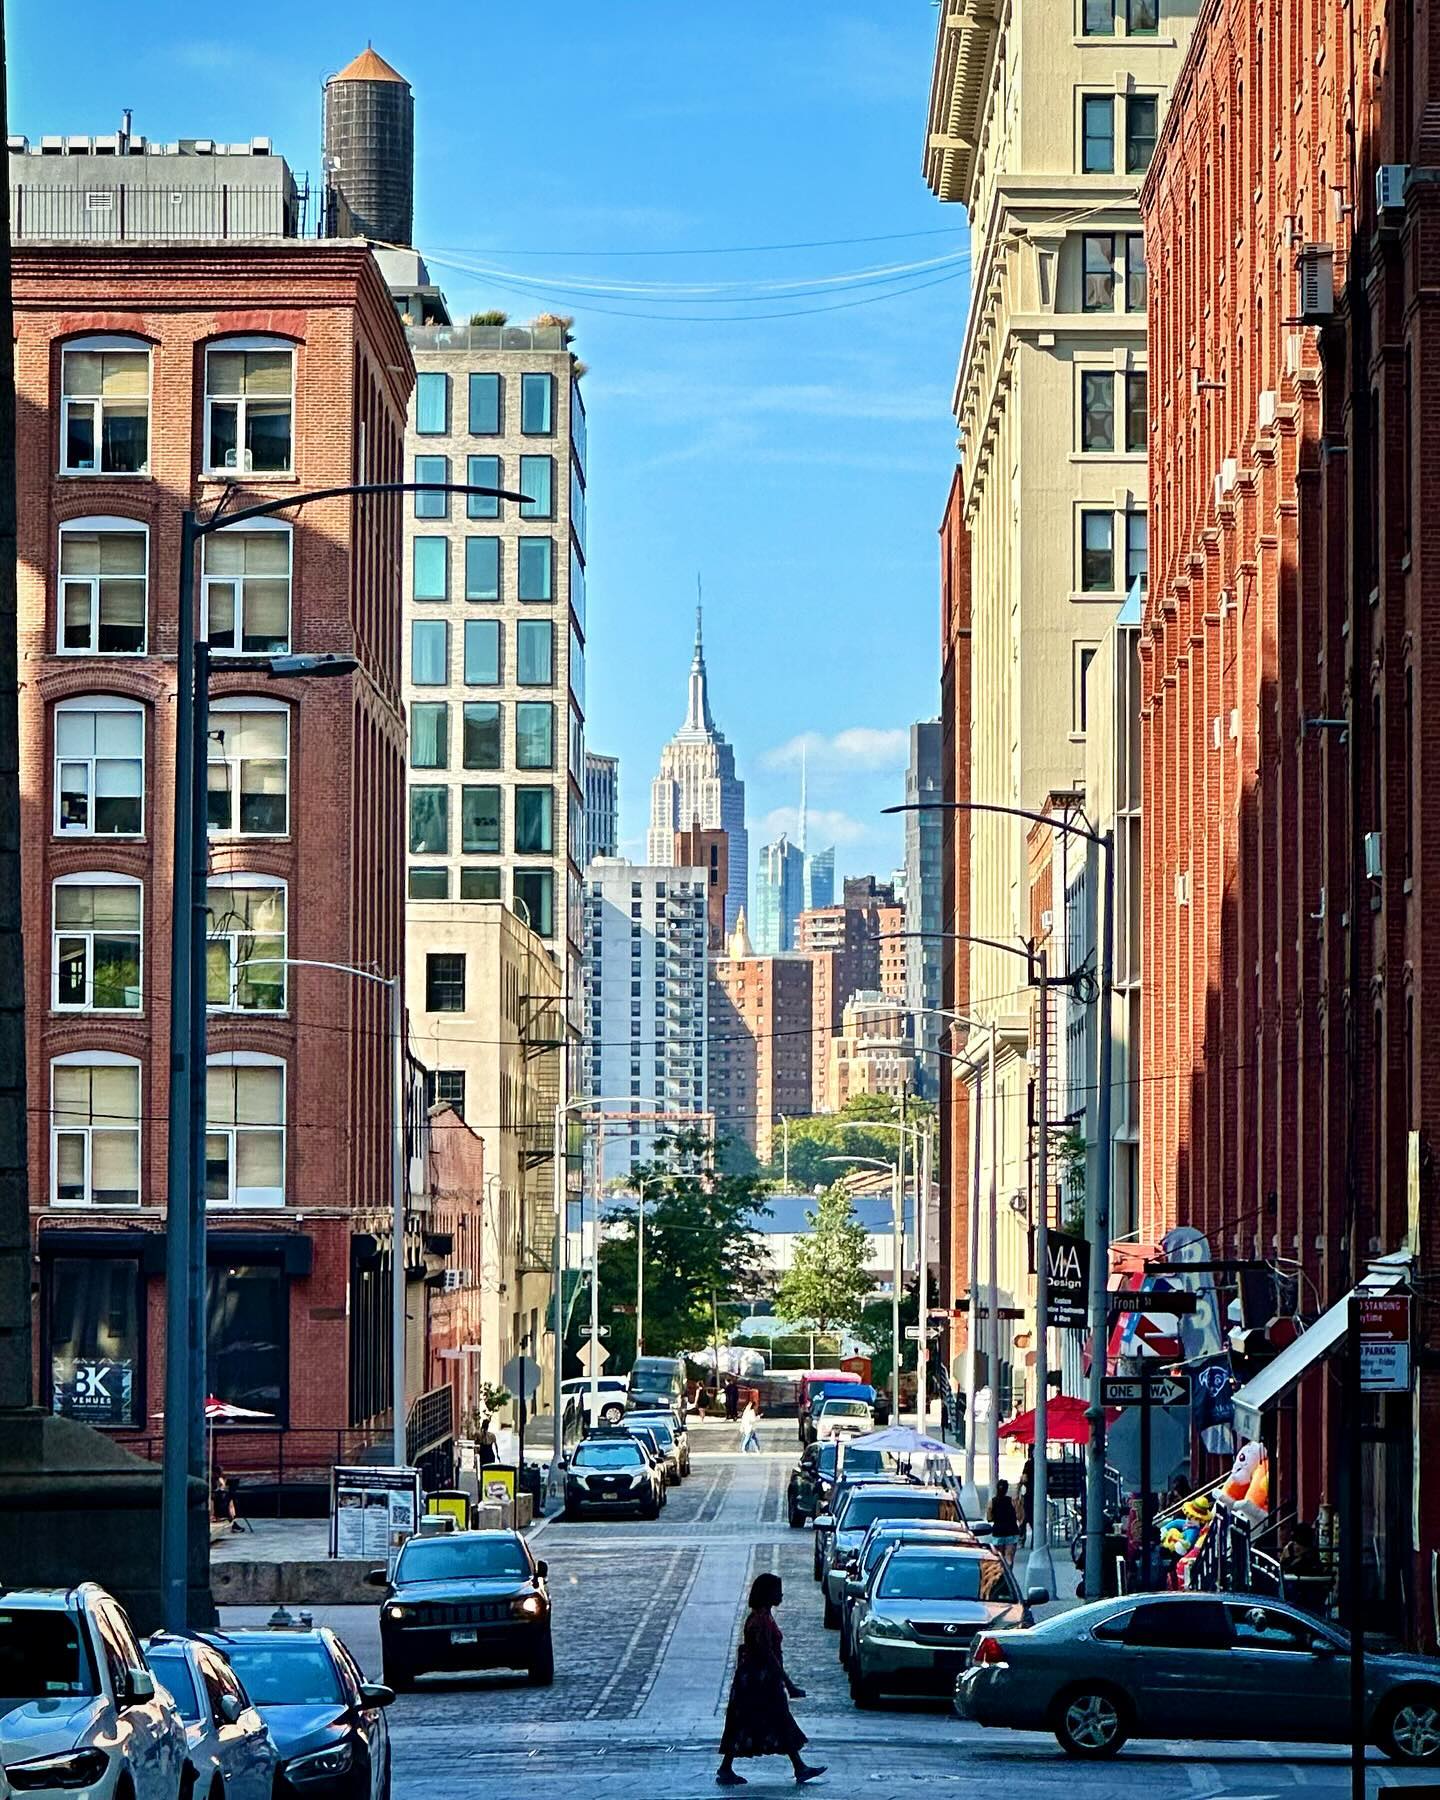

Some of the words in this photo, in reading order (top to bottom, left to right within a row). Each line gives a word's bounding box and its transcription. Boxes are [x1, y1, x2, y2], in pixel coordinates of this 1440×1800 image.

[1047, 1277, 1081, 1289] Design
[1114, 1296, 1140, 1310] Front
[1365, 1301, 1401, 1311] STANDING
[1366, 1346, 1396, 1356] PARKING
[76, 1367, 111, 1396] BK
[1109, 1385, 1134, 1398] ONE
[1150, 1385, 1175, 1398] WAY
